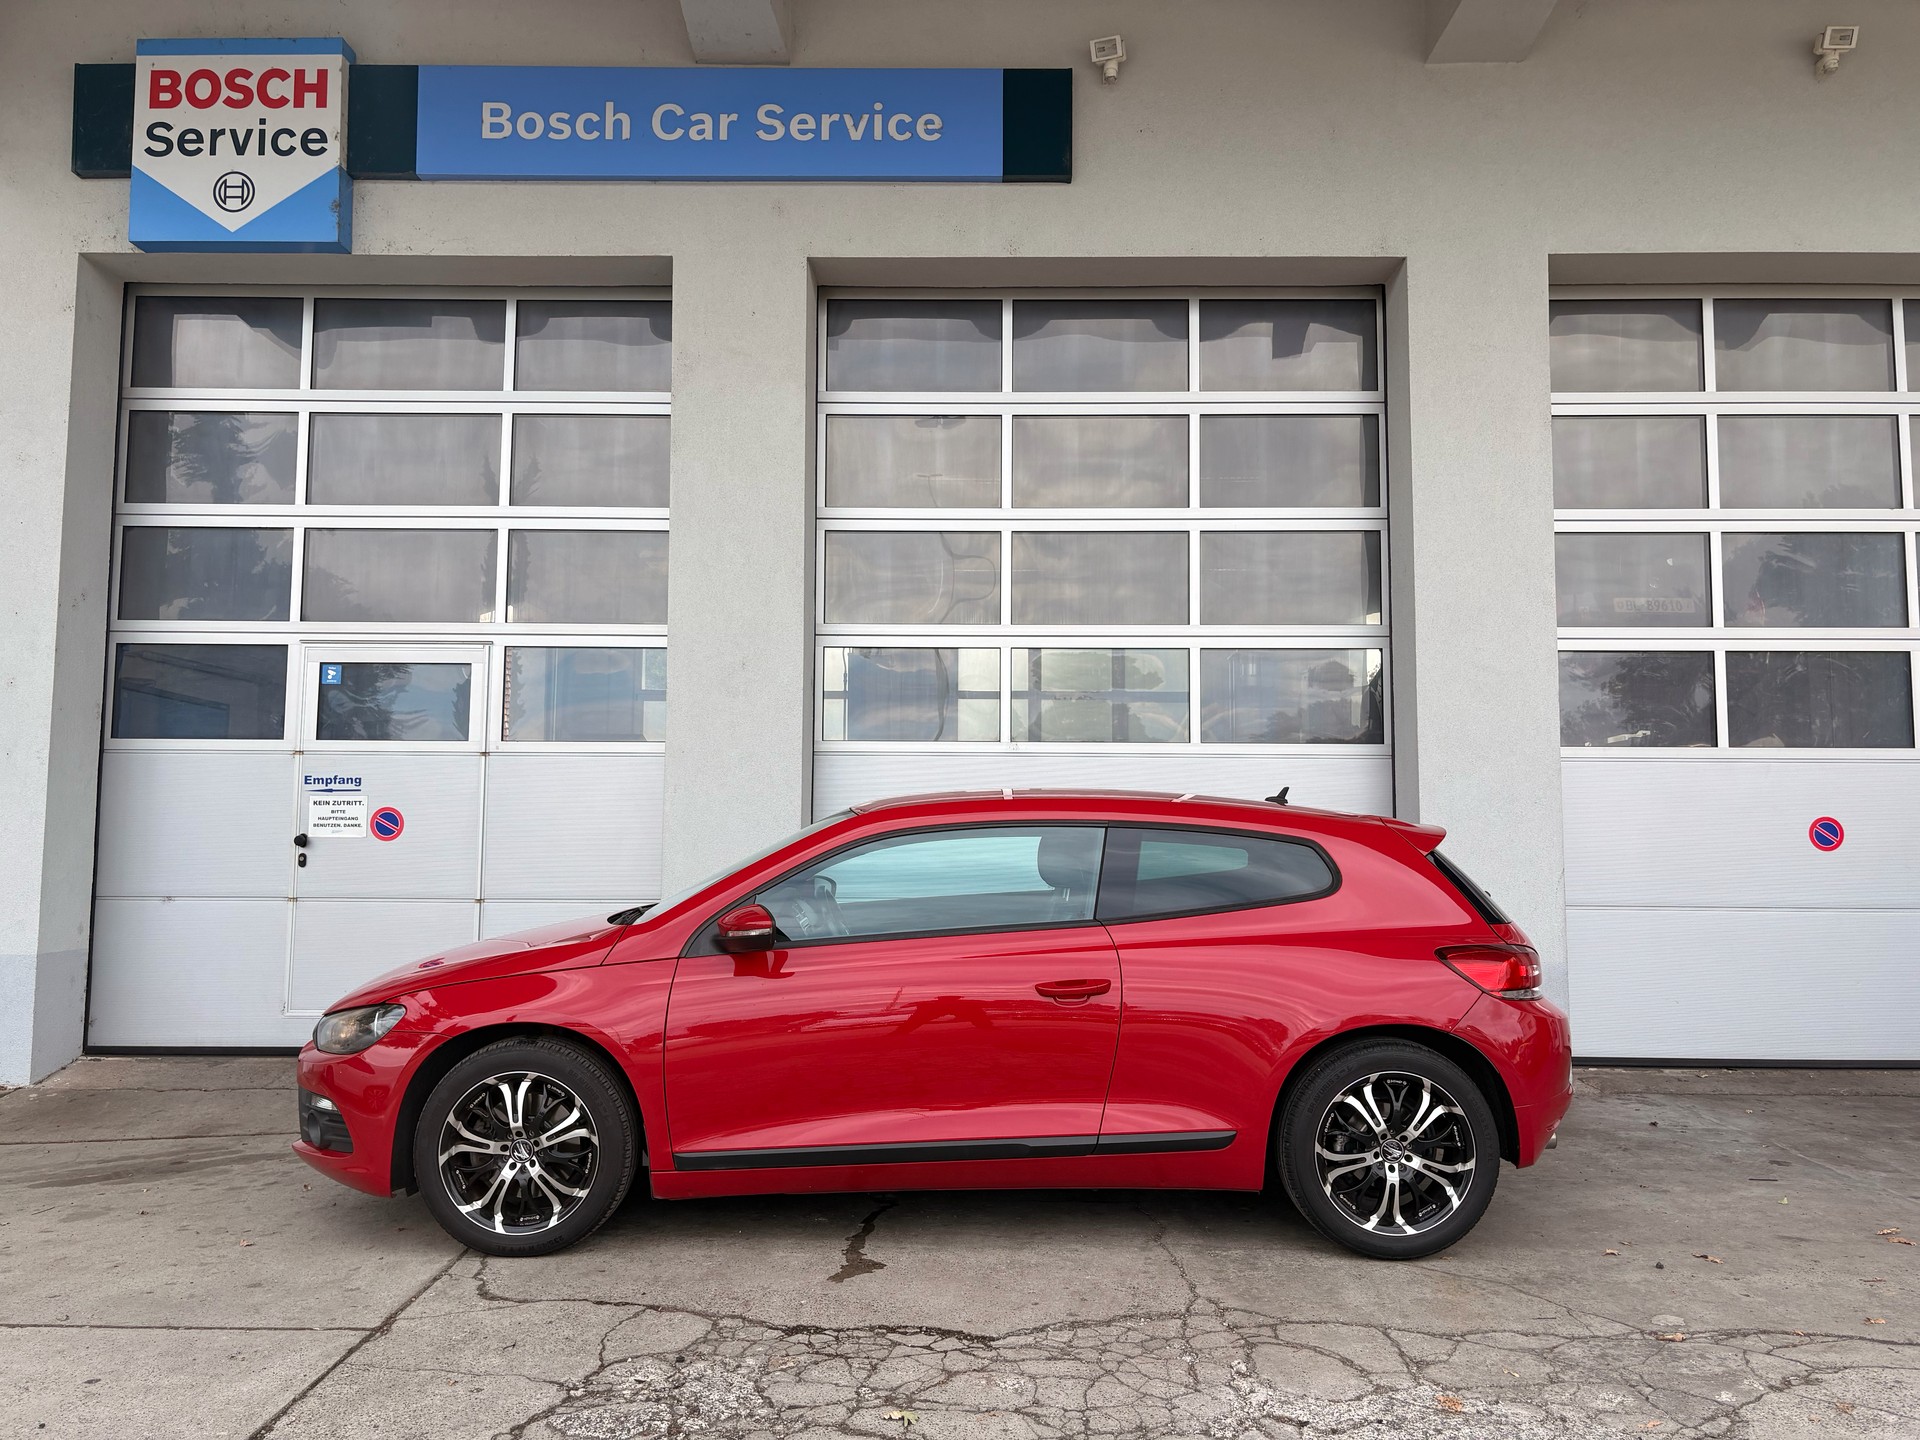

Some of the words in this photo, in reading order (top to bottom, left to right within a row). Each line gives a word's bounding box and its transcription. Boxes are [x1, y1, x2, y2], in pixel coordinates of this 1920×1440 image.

[149, 68, 329, 110] BOSCH
[144, 118, 328, 157] Service
[481, 101, 631, 141] Bosch
[651, 103, 739, 141] Car
[755, 102, 943, 141] Service
[304, 775, 362, 787] Empfang
